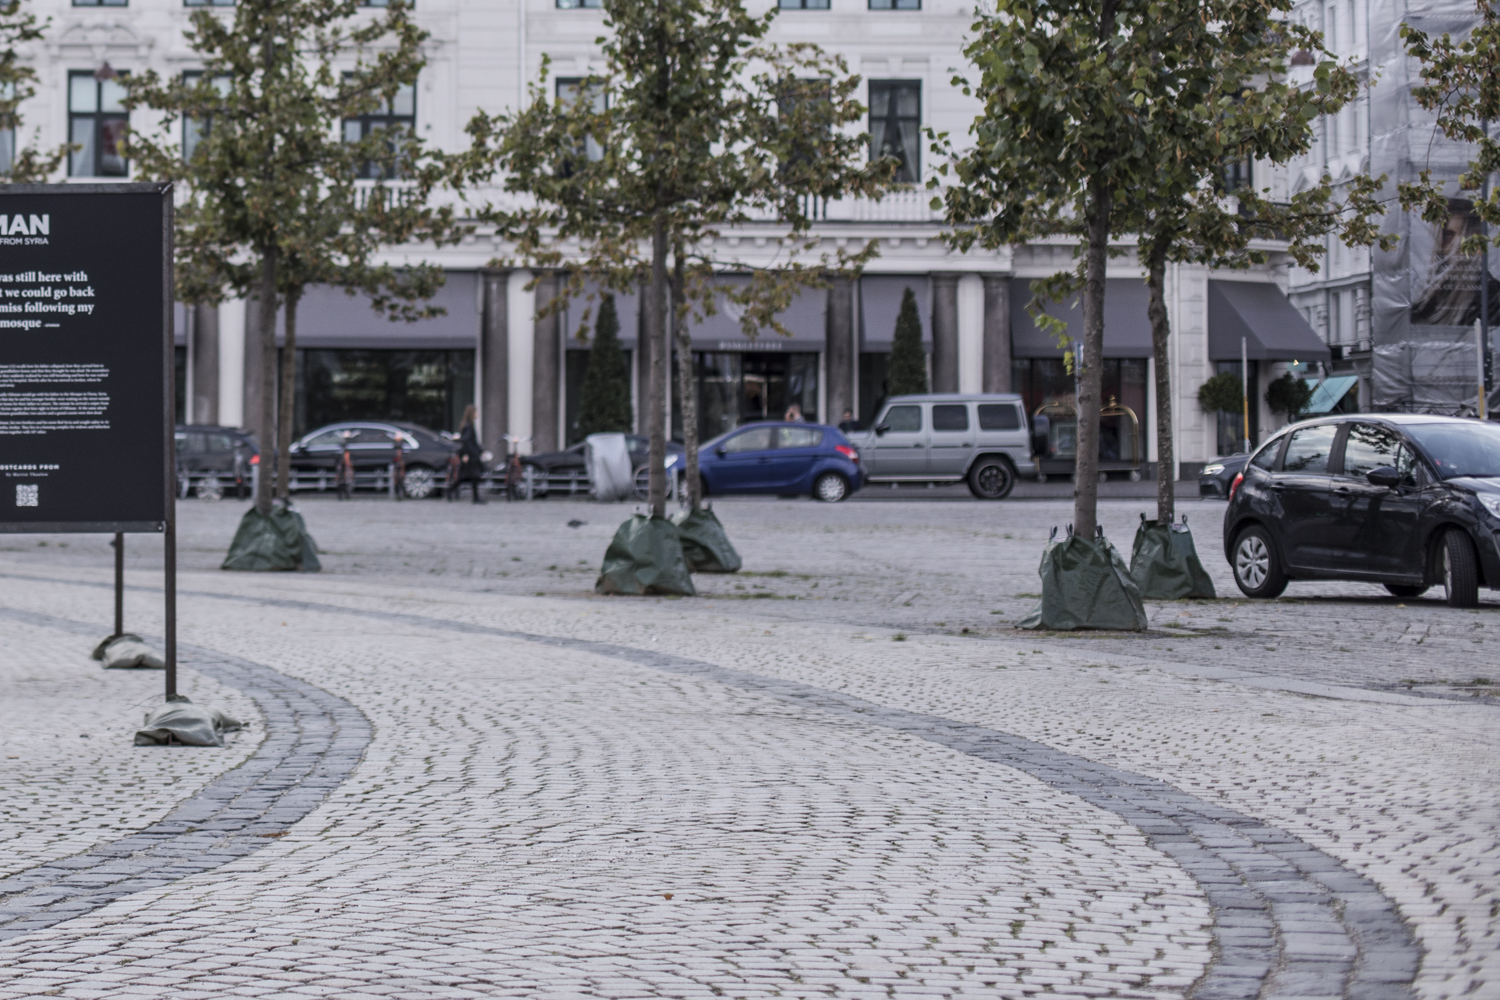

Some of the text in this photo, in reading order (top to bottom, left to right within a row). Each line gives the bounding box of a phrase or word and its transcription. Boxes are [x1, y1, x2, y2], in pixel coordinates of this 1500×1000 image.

[0, 237, 49, 245] FROM SYRIA
[15, 271, 36, 282] still
[38, 271, 62, 282] here
[63, 270, 88, 282] with
[4, 289, 20, 298] we
[21, 286, 52, 297] could
[53, 289, 68, 300] go
[69, 285, 95, 297] back
[24, 301, 76, 315] following
[77, 304, 95, 315] my
[0, 319, 42, 331] mosque
